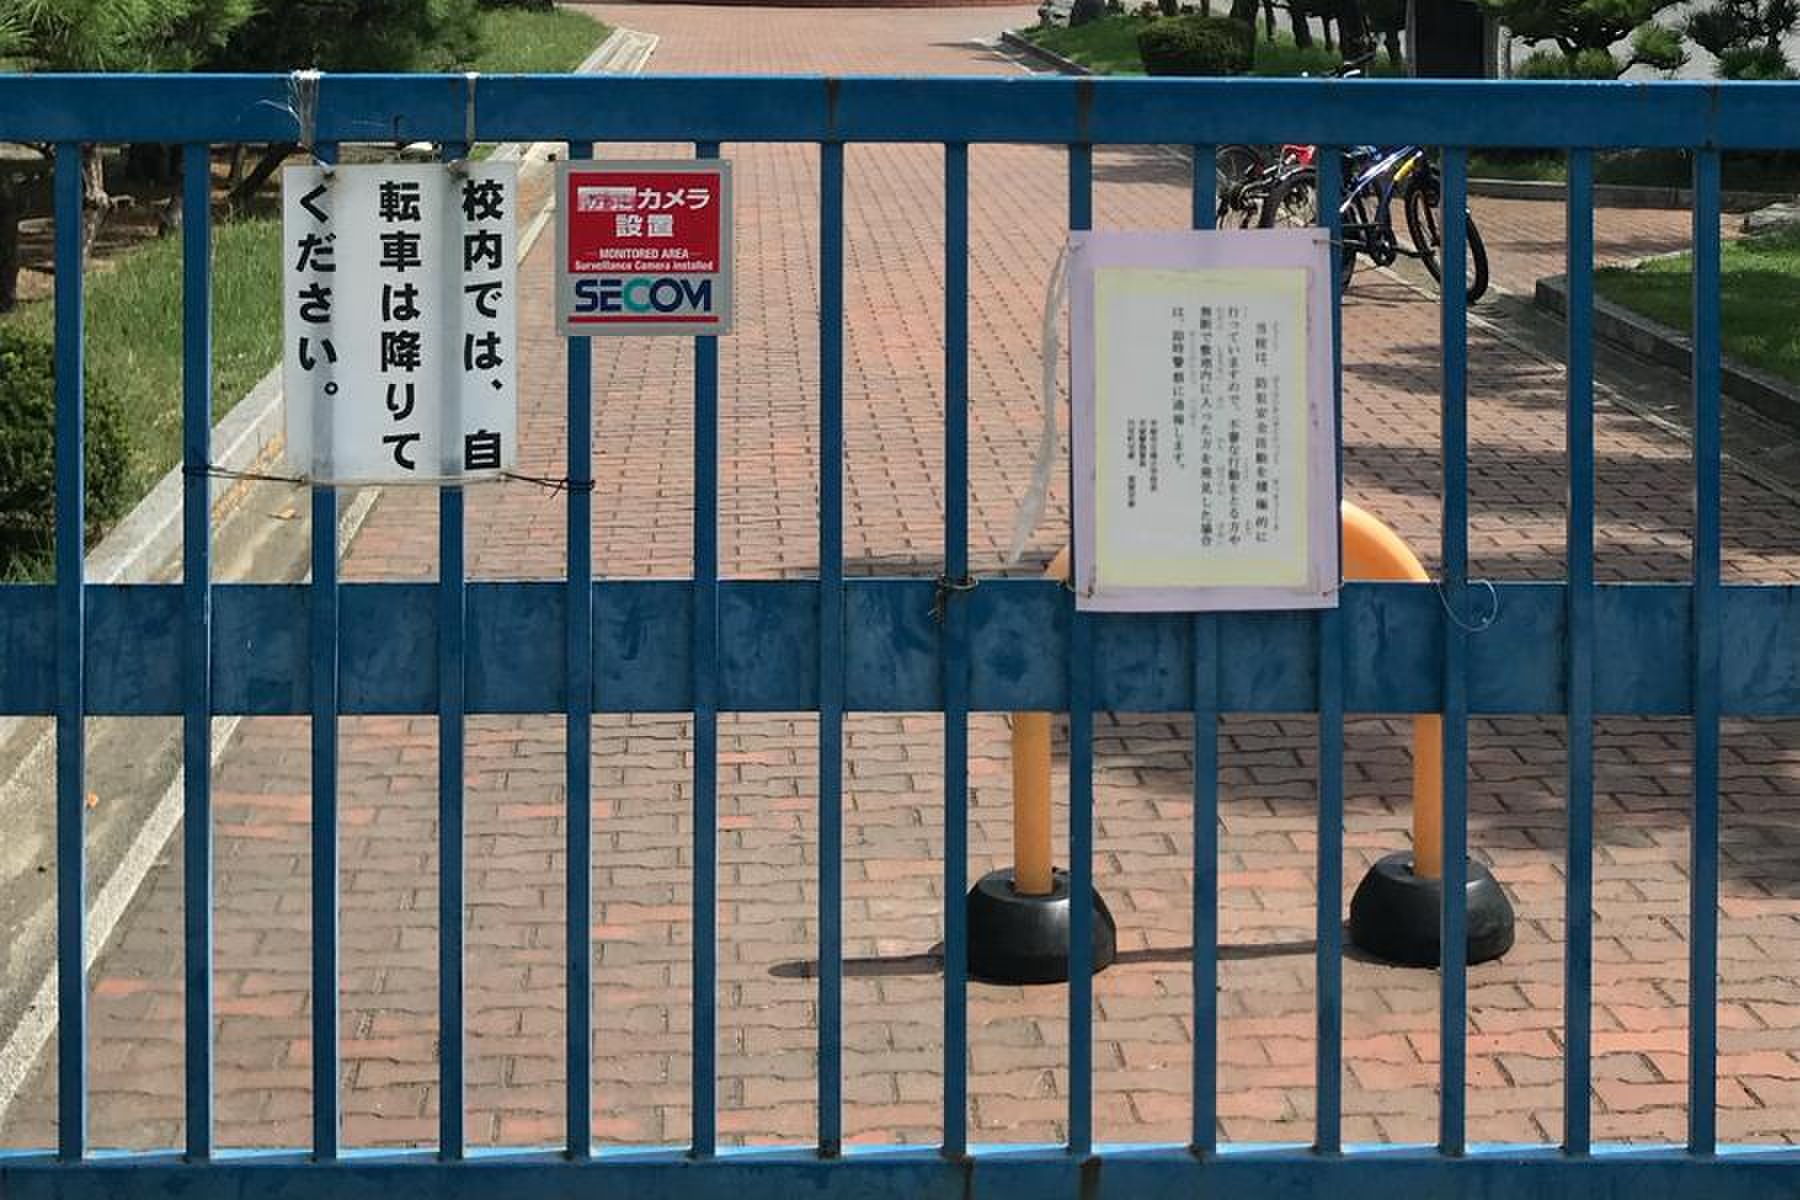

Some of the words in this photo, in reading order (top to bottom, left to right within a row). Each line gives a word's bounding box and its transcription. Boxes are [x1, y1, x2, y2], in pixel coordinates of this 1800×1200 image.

[615, 214, 673, 237] 設置
[575, 260, 632, 271] Surveillance
[634, 260, 671, 271] Camera
[600, 248, 658, 259] MONITORED
[661, 248, 689, 259] AREA
[296, 183, 339, 397] ください。
[575, 278, 712, 313] SECOM
[379, 180, 421, 471] 転車は降りて
[462, 180, 504, 470] 校内では、自
